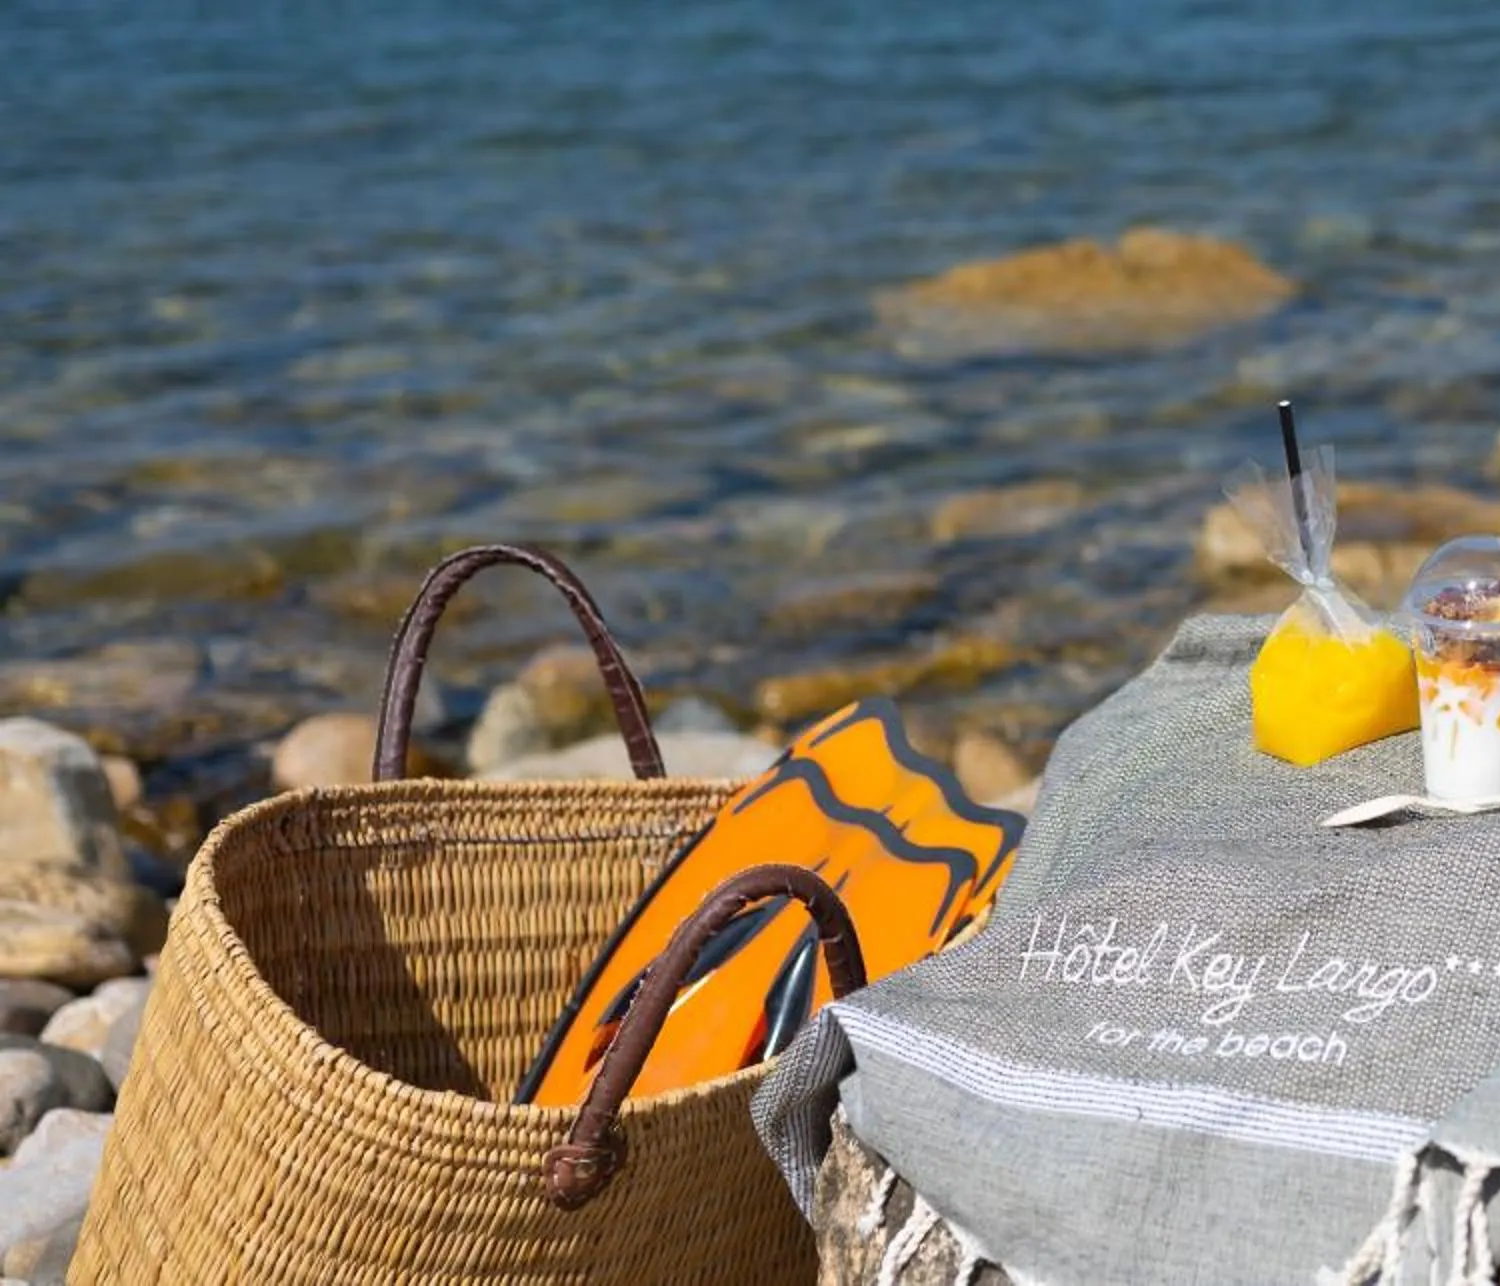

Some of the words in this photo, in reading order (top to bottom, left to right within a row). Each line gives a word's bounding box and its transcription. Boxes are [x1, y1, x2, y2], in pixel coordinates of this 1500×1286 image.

[1020, 913, 1168, 985] Hôtel
[1169, 922, 1268, 1025] Key
[1276, 930, 1438, 1023] Largo
[1085, 1021, 1141, 1047] for
[1148, 1025, 1210, 1057] the
[1215, 1027, 1349, 1066] beach
